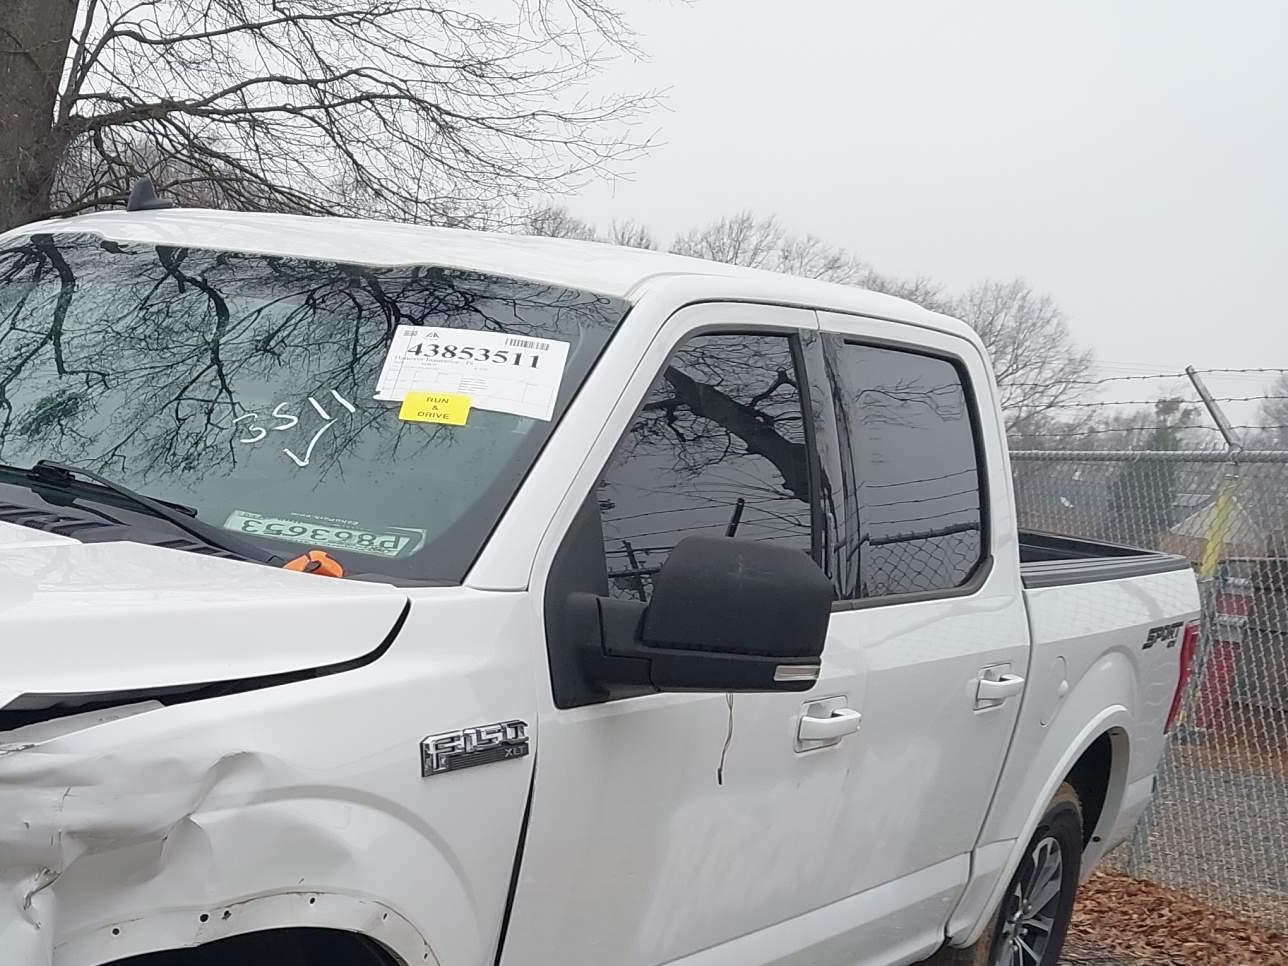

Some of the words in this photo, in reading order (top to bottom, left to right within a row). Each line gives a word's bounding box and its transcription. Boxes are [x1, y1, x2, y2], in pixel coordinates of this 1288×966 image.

[407, 342, 540, 369] 43853511
[426, 396, 450, 404] RUN
[417, 411, 450, 420] DRIVE
[241, 519, 401, 550] P863653
[1142, 621, 1185, 650] SPORT
[504, 746, 528, 758] XLT
